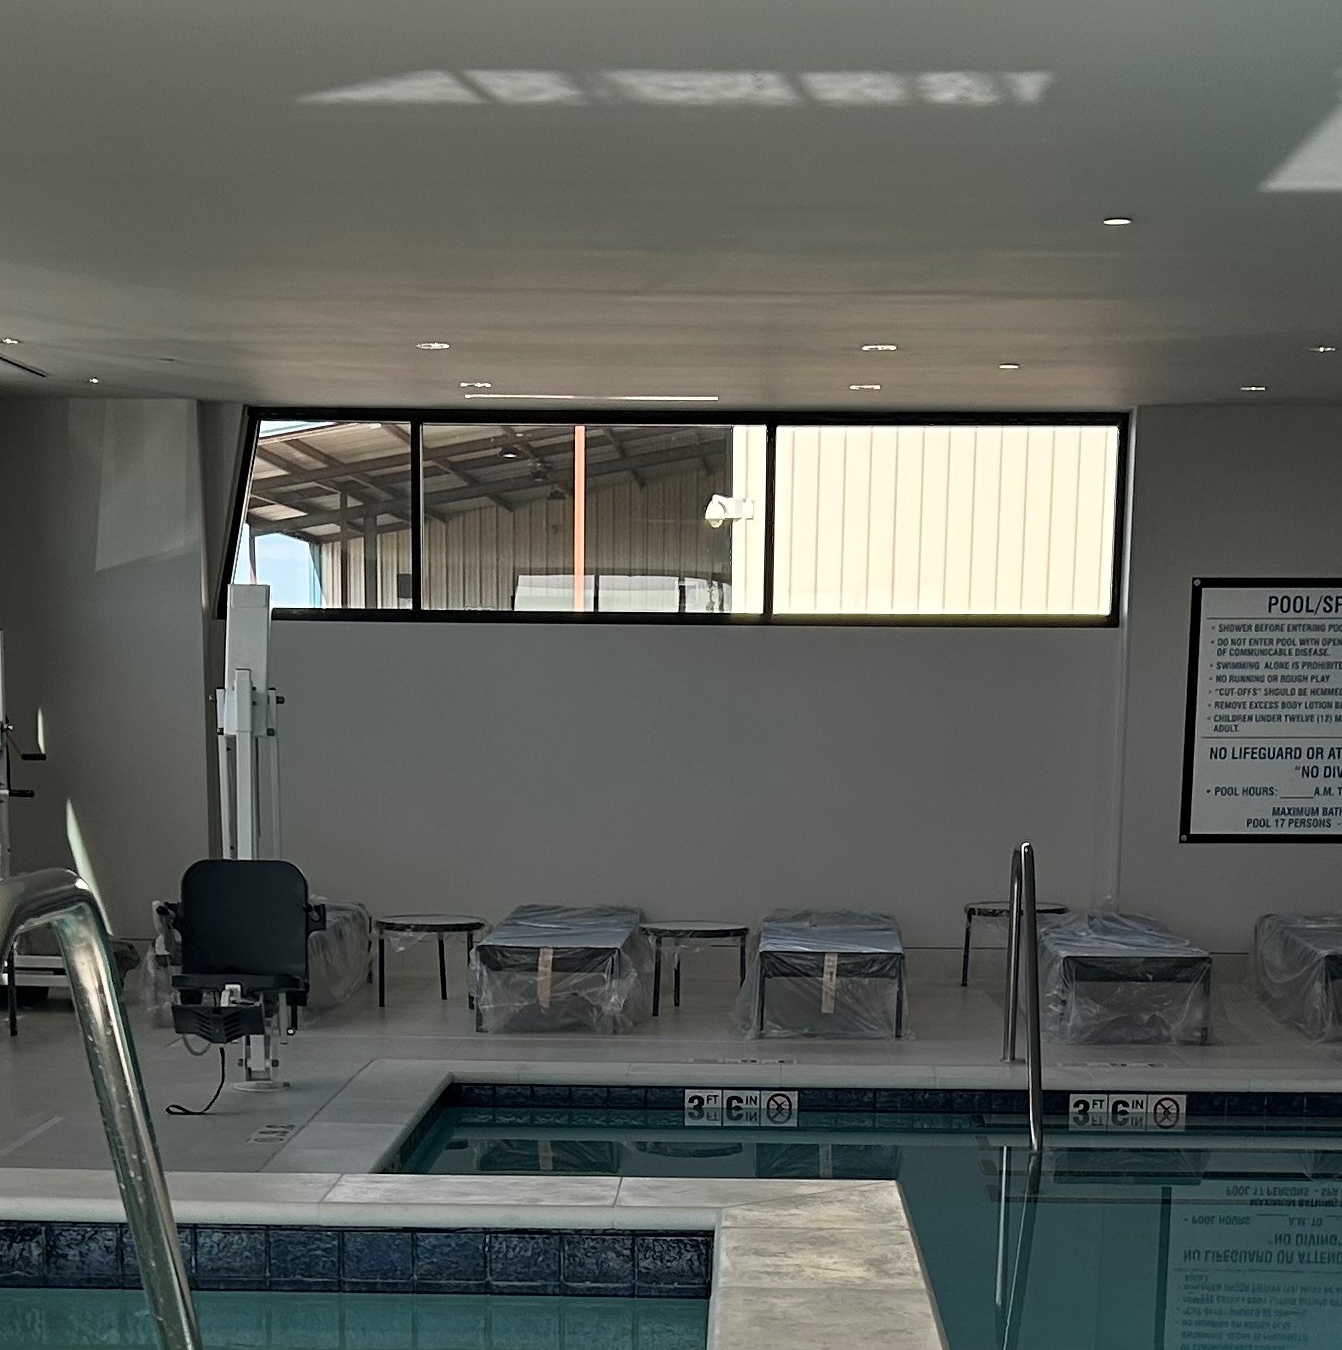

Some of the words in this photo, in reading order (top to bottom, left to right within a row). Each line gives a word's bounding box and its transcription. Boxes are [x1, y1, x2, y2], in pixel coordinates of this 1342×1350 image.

[1210, 747, 1226, 760] NO
[1231, 747, 1302, 760] LIFEGUARD
[1307, 747, 1324, 760] OR
[1214, 787, 1239, 796] POOL
[1272, 807, 1319, 816] MAXIMUM
[1246, 819, 1271, 828] POOL
[1275, 819, 1285, 828] 17
[1288, 819, 1331, 828] PERSONS
[688, 1095, 704, 1116] 3
[707, 1095, 719, 1104] FT
[746, 1096, 757, 1105] IN
[1073, 1099, 1090, 1121] 3
[1092, 1099, 1105, 1109] FT
[1132, 1099, 1143, 1109] IN
